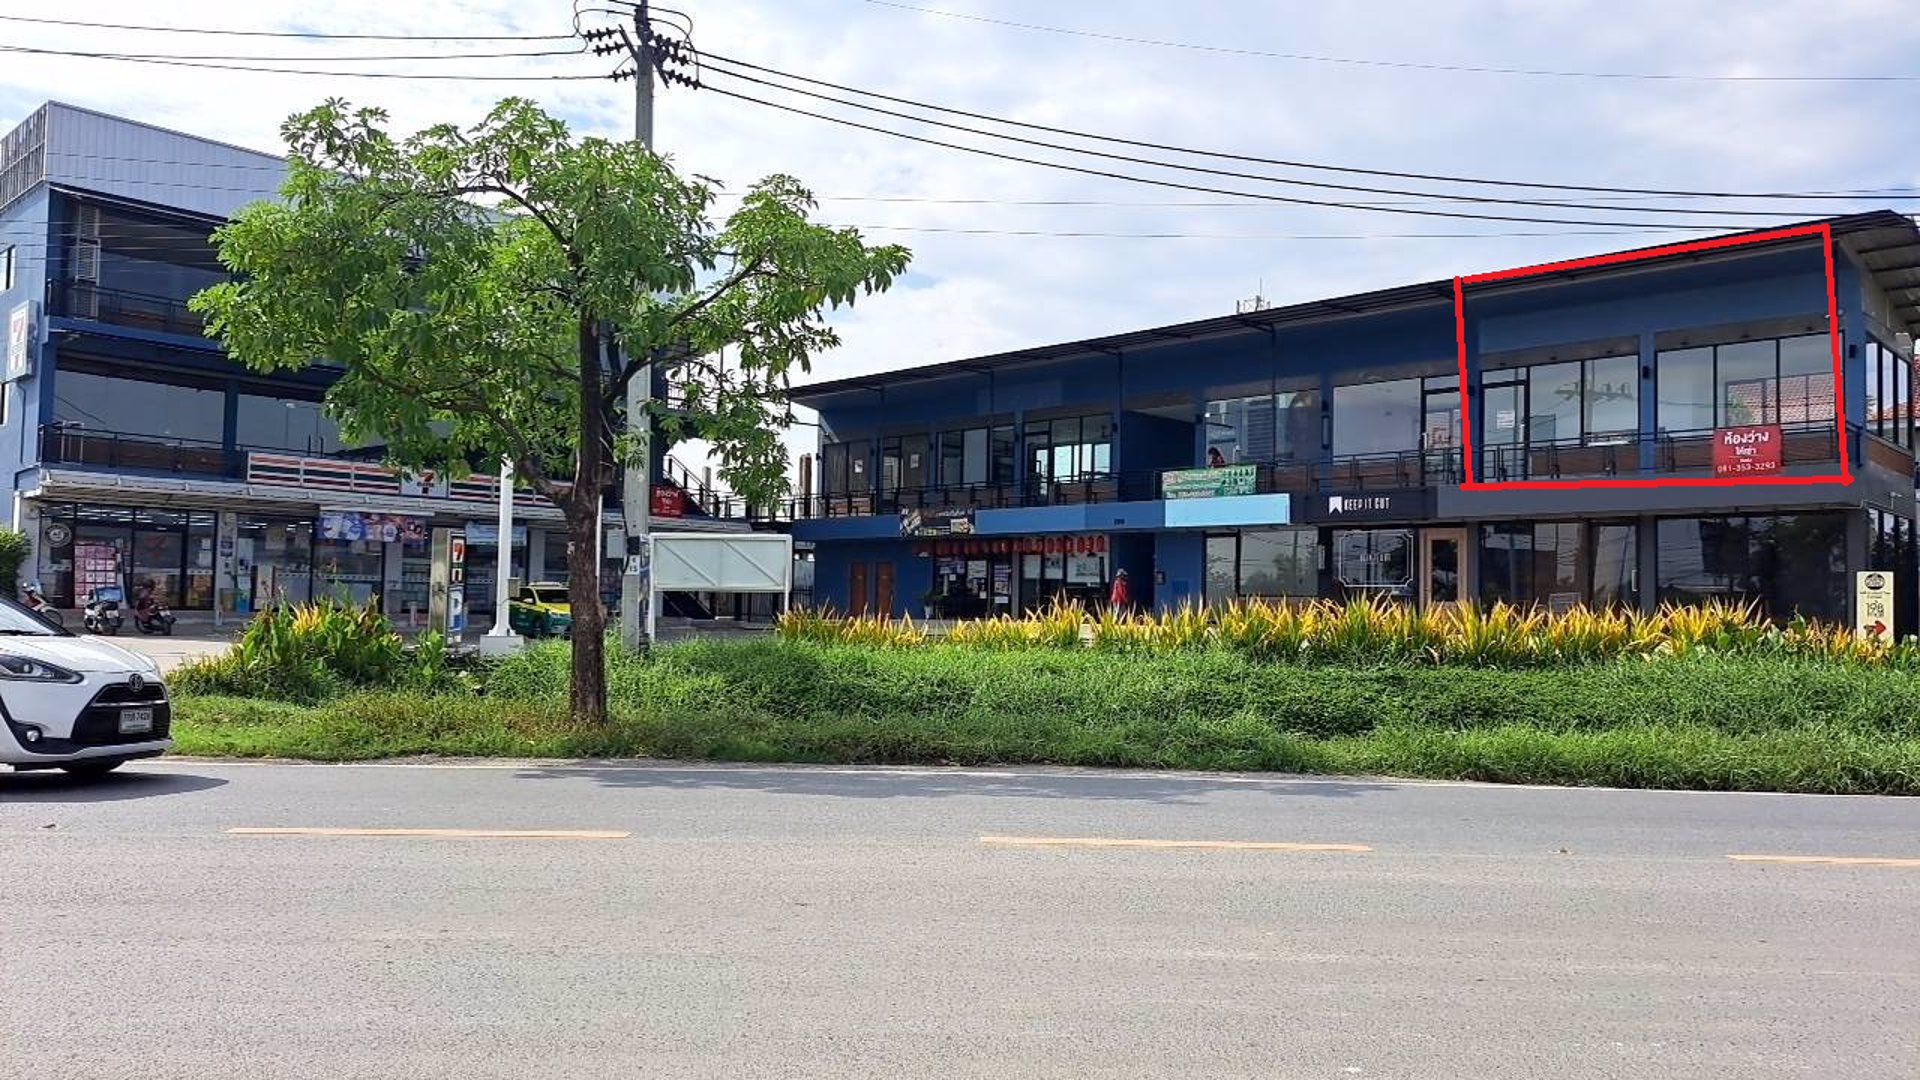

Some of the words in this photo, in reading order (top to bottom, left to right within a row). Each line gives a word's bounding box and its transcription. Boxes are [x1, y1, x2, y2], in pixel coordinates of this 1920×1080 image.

[1724, 430, 1769, 445] ห้องว่าง
[1344, 498, 1363, 511] KEEP
